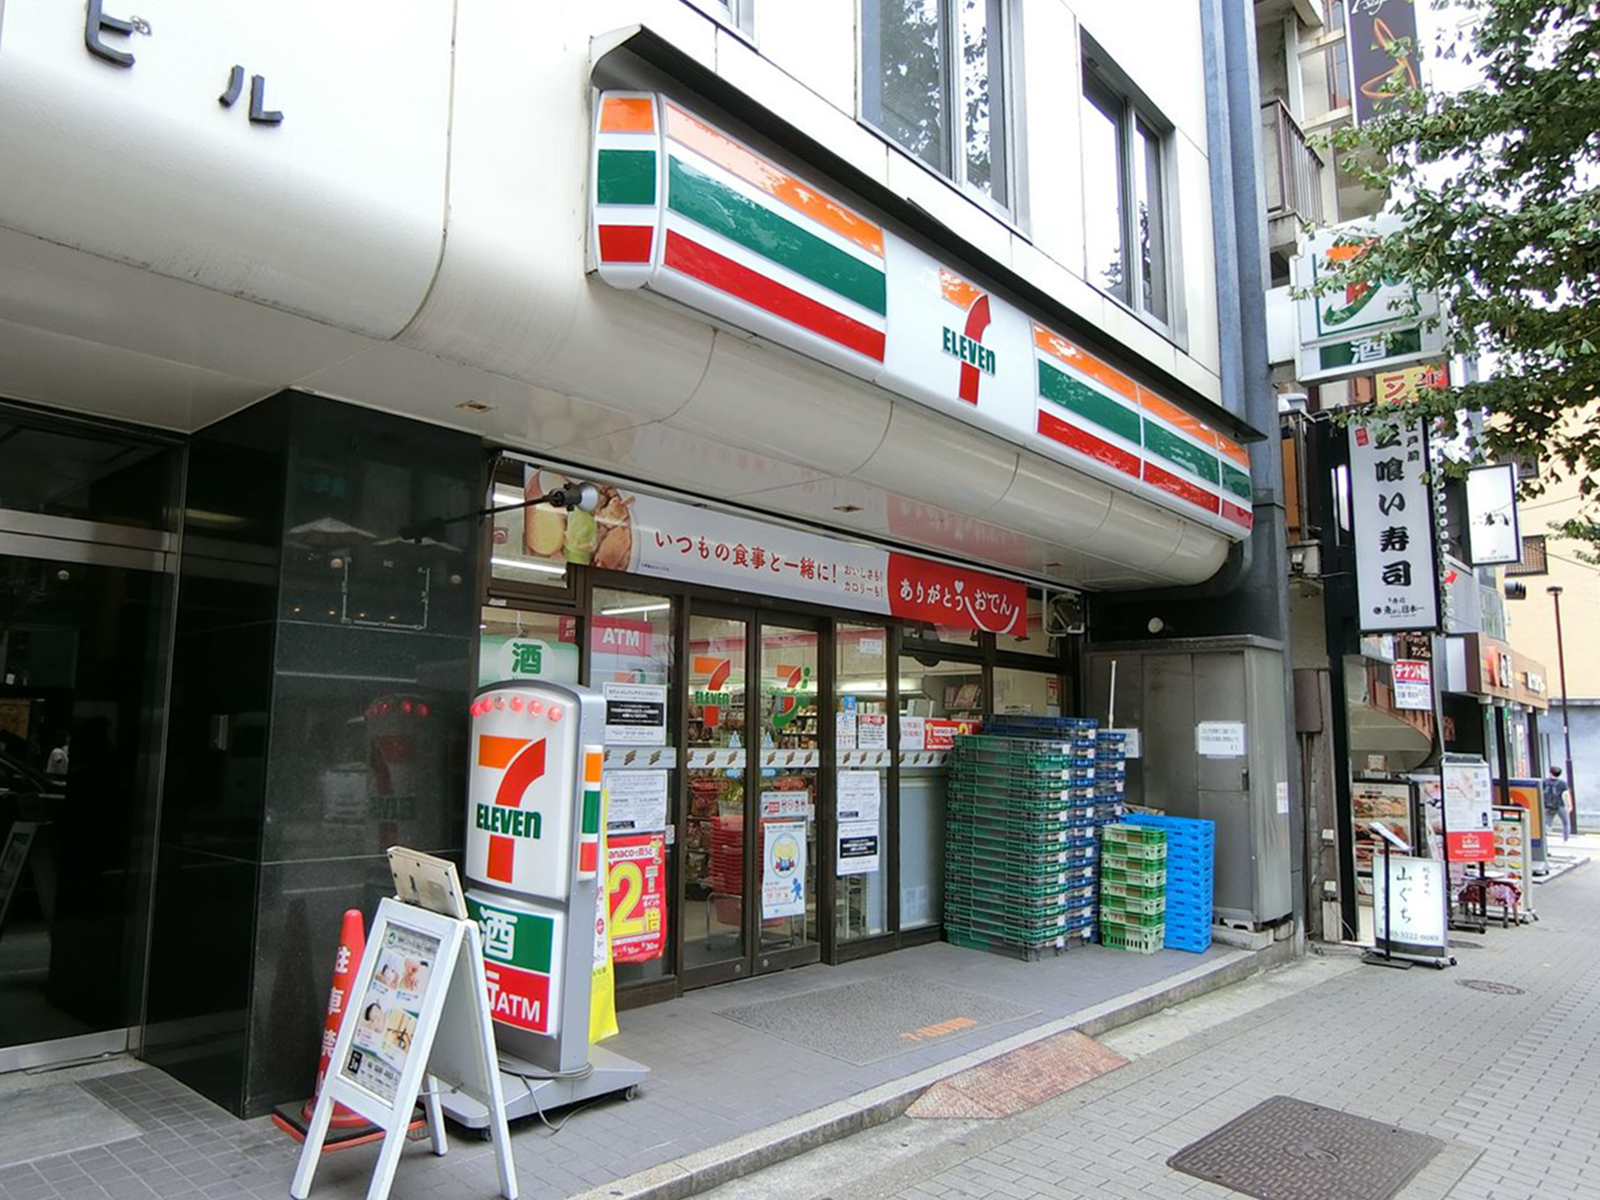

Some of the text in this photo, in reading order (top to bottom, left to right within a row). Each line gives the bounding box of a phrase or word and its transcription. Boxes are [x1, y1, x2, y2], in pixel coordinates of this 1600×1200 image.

[1351, 337, 1387, 364] 酒
[655, 530, 837, 584] いつもの食事と一緒に!
[602, 626, 640, 648] ATM
[511, 642, 542, 675] 酒
[479, 906, 518, 961] 酒
